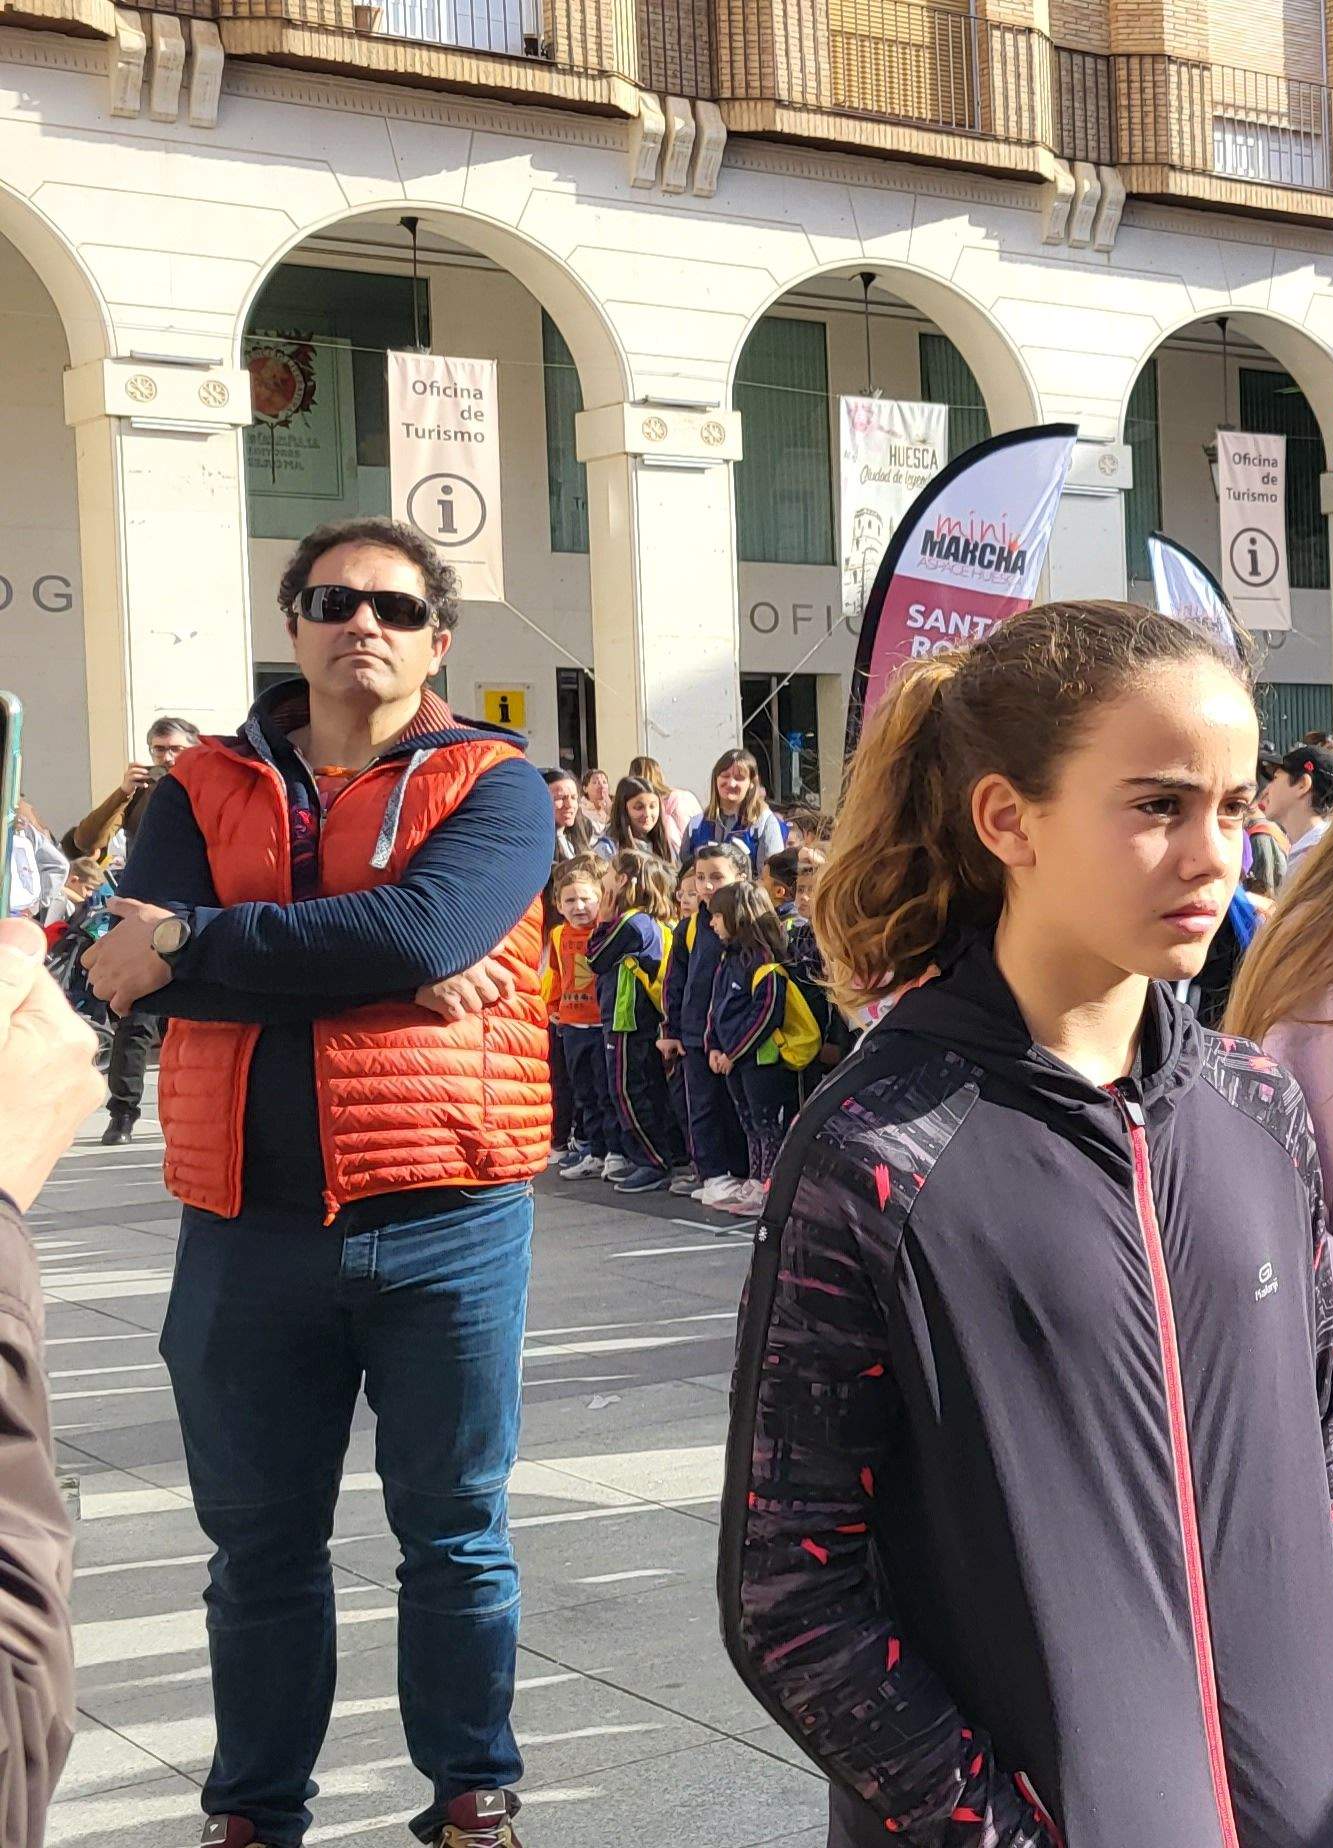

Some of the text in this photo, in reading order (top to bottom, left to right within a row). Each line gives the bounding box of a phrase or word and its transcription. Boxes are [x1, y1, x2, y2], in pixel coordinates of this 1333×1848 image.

[412, 379, 484, 401] Oficina
[460, 406, 485, 422] de
[401, 422, 486, 444] Turismo
[889, 444, 939, 470] HUESCA
[1232, 452, 1279, 468] Oficina
[860, 464, 892, 485] Ciudad
[893, 468, 903, 484] de
[1261, 472, 1278, 486] de
[1226, 487, 1278, 504] Turismo
[936, 511, 1008, 544] mini
[920, 530, 1028, 576] MARCHA
